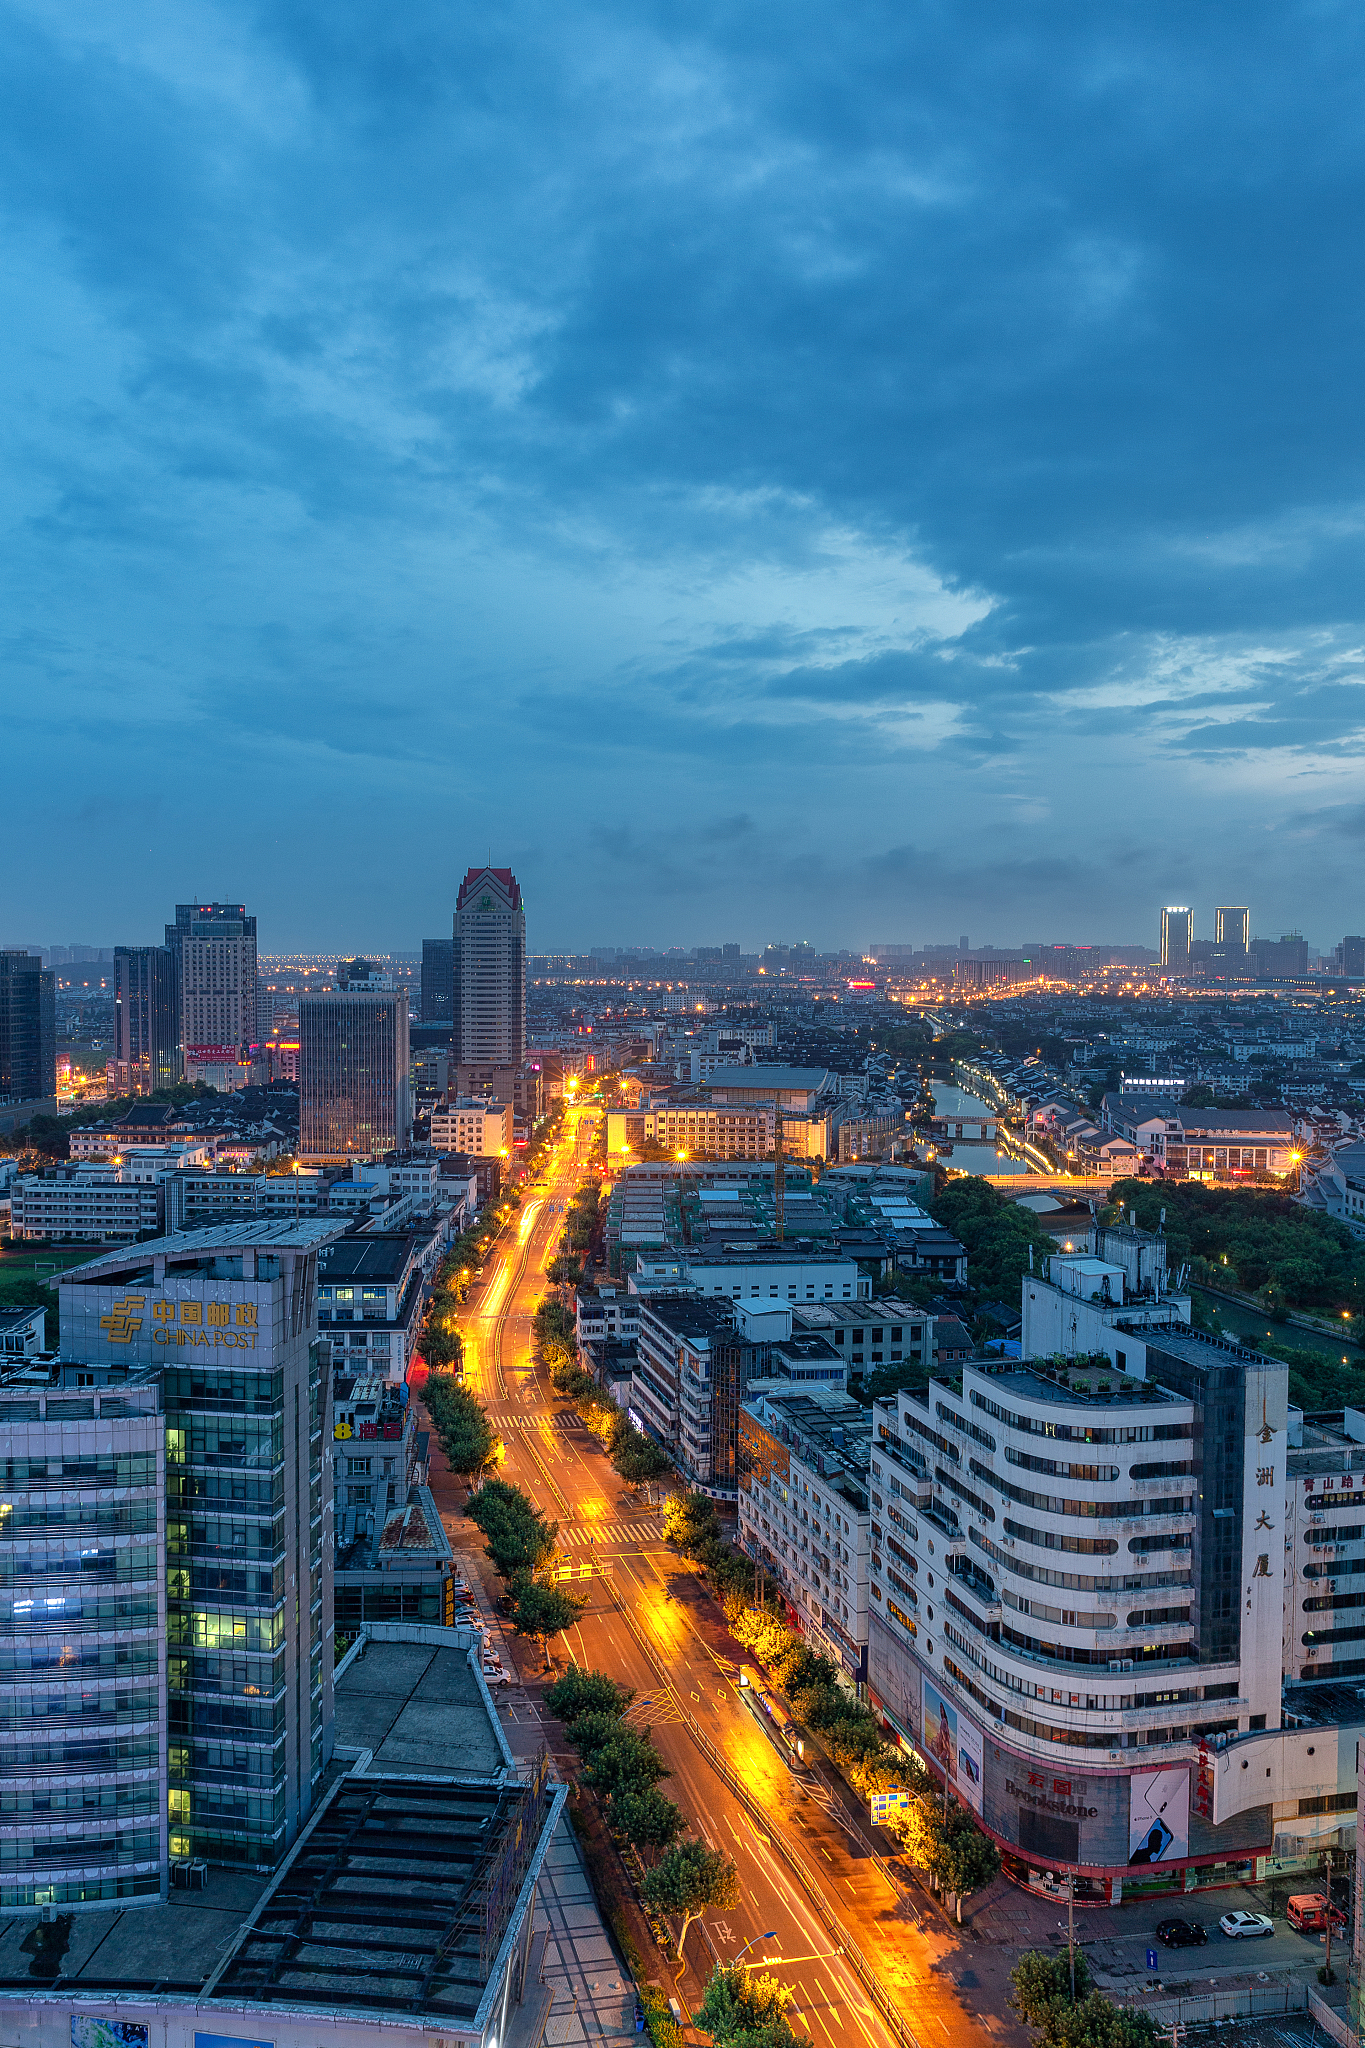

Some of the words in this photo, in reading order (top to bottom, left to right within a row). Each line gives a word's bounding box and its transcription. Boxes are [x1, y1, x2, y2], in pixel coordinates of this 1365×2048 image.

[152, 1299, 259, 1328] 中国邮政
[153, 1328, 208, 1347] CHINA
[213, 1331, 259, 1349] POST
[1252, 1422, 1278, 1578] 金洲大厦
[1005, 1777, 1098, 1818] Brookstone
[1027, 1771, 1071, 1796] 宏图
